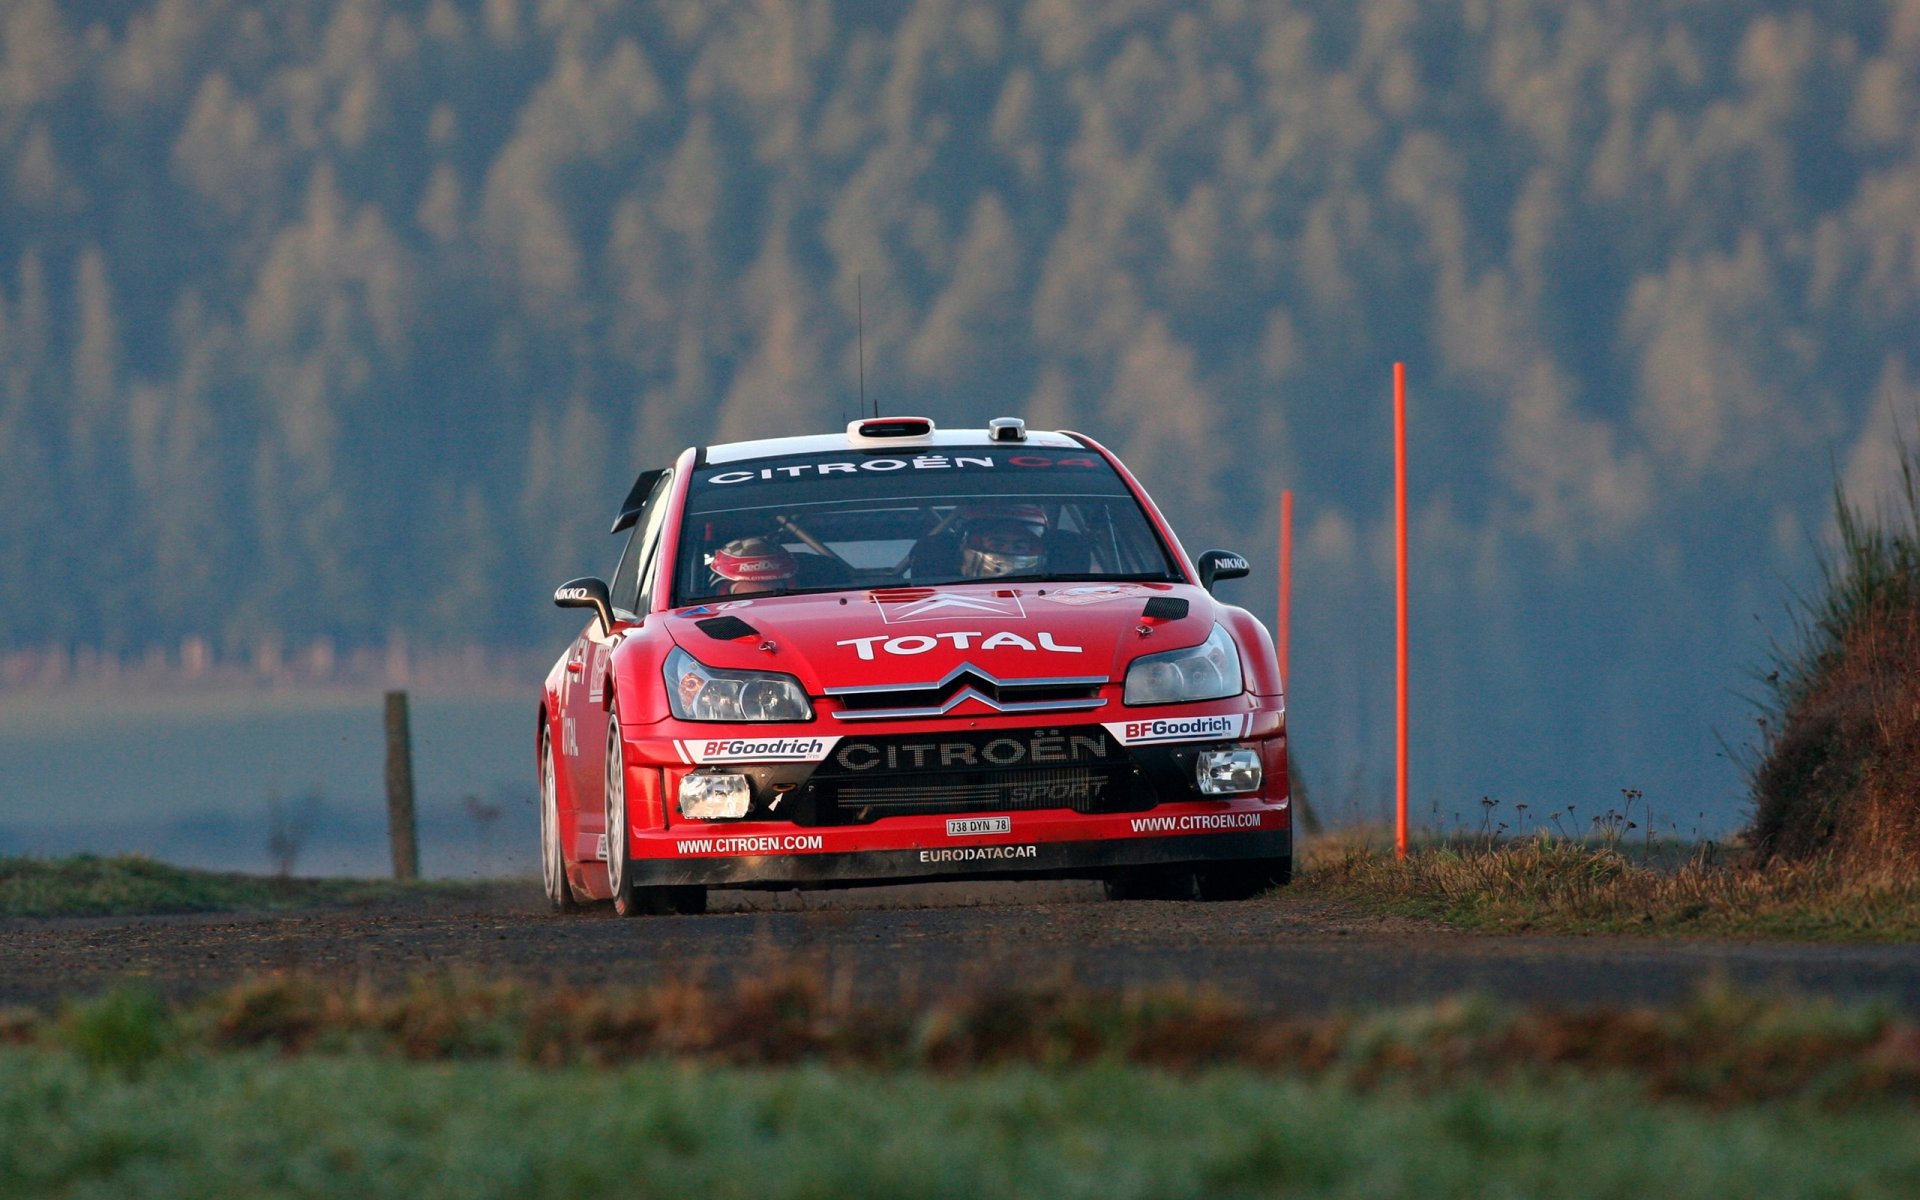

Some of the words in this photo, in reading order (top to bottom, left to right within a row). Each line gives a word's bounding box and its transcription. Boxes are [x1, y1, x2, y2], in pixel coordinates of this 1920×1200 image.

[708, 455, 994, 484] CITROËN
[1008, 456, 1099, 468] C4
[1214, 558, 1248, 570] NIKKO
[837, 631, 1083, 661] TOTAL
[1126, 717, 1232, 738] BFGoodrich
[703, 739, 823, 756] BFGoodrich
[837, 729, 1106, 770] CITROËN
[1010, 781, 1108, 802] SPORT
[950, 822, 968, 832] 738
[970, 820, 991, 832] DYN
[996, 819, 1007, 830] 78
[1130, 814, 1261, 832] WWW.CITROEN.COM
[676, 835, 823, 854] WWW.CITROEN.COM
[919, 845, 1037, 863] EURODATACAR
